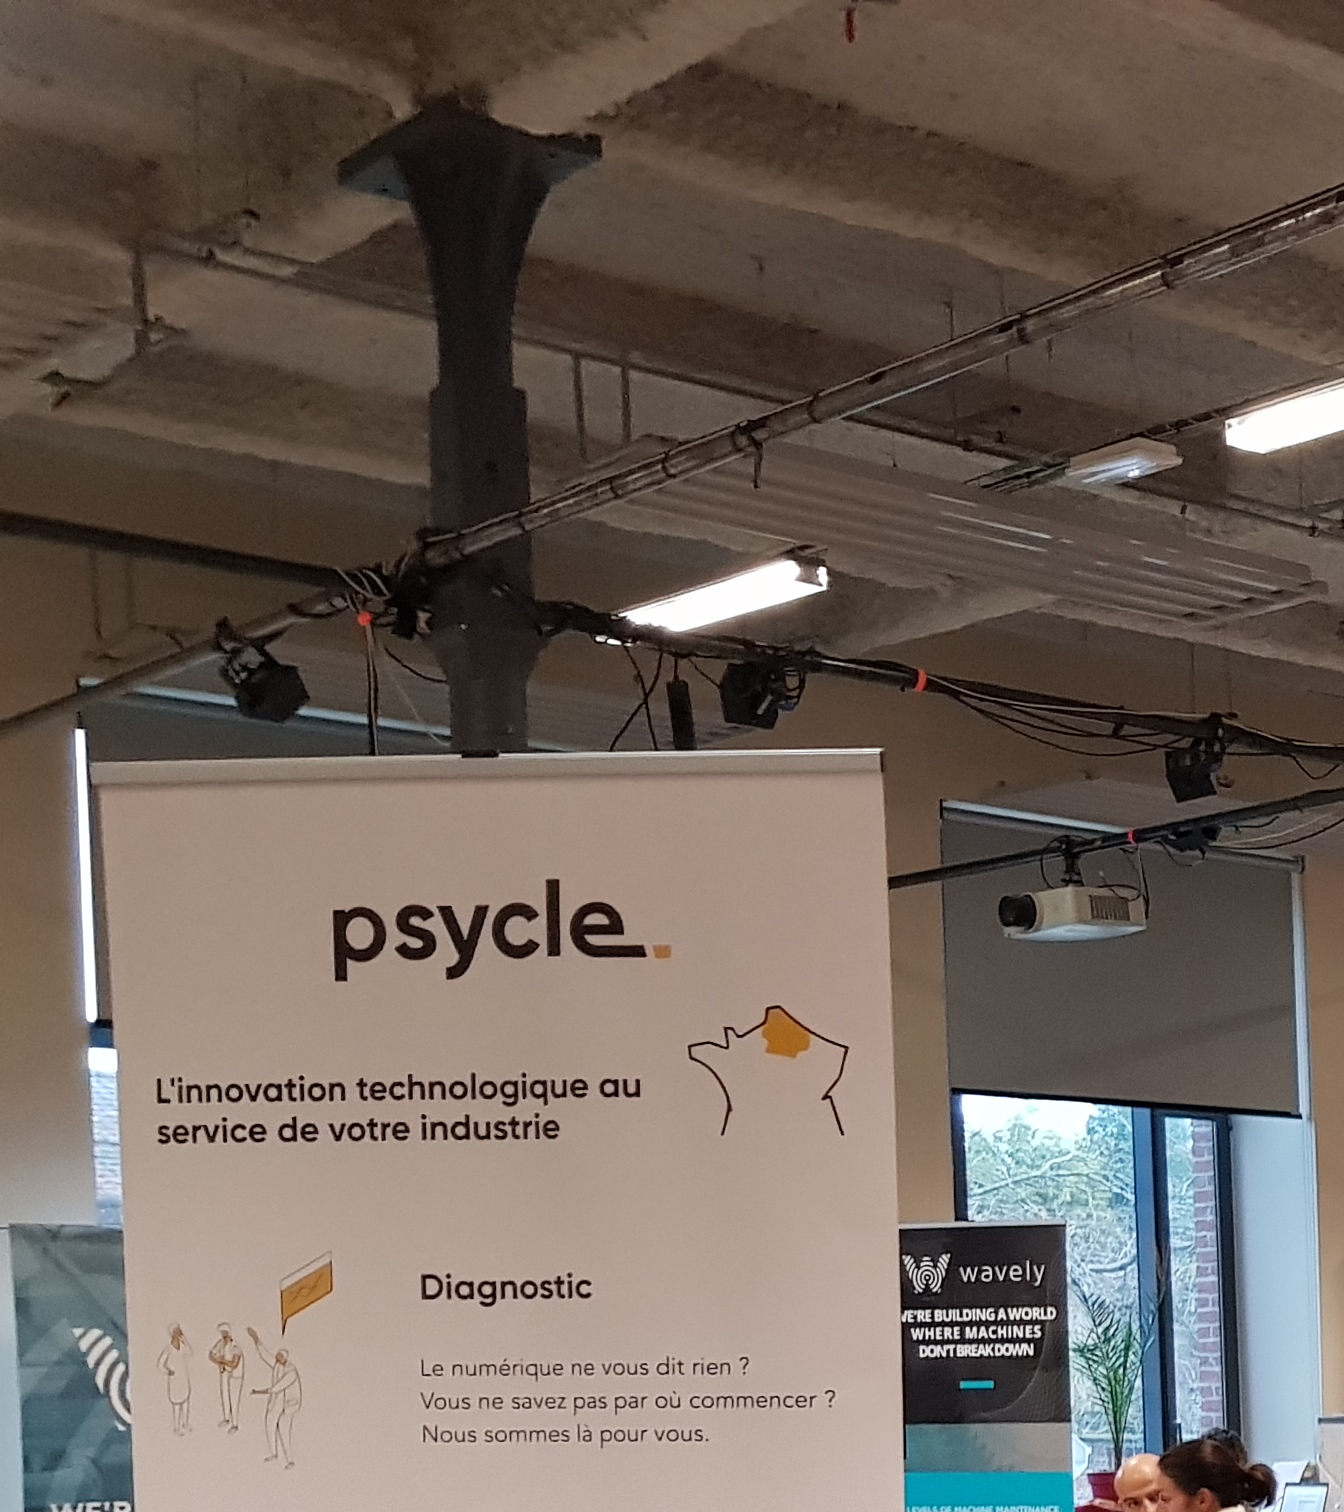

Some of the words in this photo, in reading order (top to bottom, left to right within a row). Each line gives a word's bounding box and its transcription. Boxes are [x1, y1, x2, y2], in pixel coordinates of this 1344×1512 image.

[156, 1074, 347, 1105] L'innovation
[355, 1071, 589, 1108] technologique
[598, 1077, 642, 1099] au
[156, 1116, 268, 1146] service
[277, 1115, 320, 1144] de
[327, 1117, 411, 1143] votre
[420, 1111, 561, 1142] industrie
[959, 1260, 1045, 1287] wavely
[420, 1271, 593, 1308] Diagnostic
[934, 1307, 995, 1322] BUILDING
[997, 1307, 1007, 1321] A
[1007, 1306, 1057, 1321] WORLD
[910, 1326, 961, 1341] WHERE
[965, 1325, 1042, 1340] MACHINES
[919, 1344, 955, 1358] DON'T
[420, 1358, 445, 1378] Le
[451, 1357, 565, 1383] numérique
[571, 1362, 595, 1377] ne
[601, 1362, 650, 1376] vous
[655, 1355, 686, 1376] dit
[692, 1357, 732, 1376] rien
[738, 1356, 750, 1376] ?
[419, 1391, 472, 1411] Vous
[478, 1396, 505, 1411] ne
[511, 1396, 568, 1410] savez
[573, 1395, 609, 1417] pas
[613, 1395, 649, 1417] par
[654, 1390, 682, 1410] où
[688, 1394, 819, 1410] commencer
[823, 1389, 837, 1409] ?
[422, 1424, 478, 1444] Nous
[483, 1429, 571, 1444] sommes
[576, 1422, 593, 1443] là
[599, 1428, 649, 1450] pour
[653, 1428, 710, 1443] vous.
